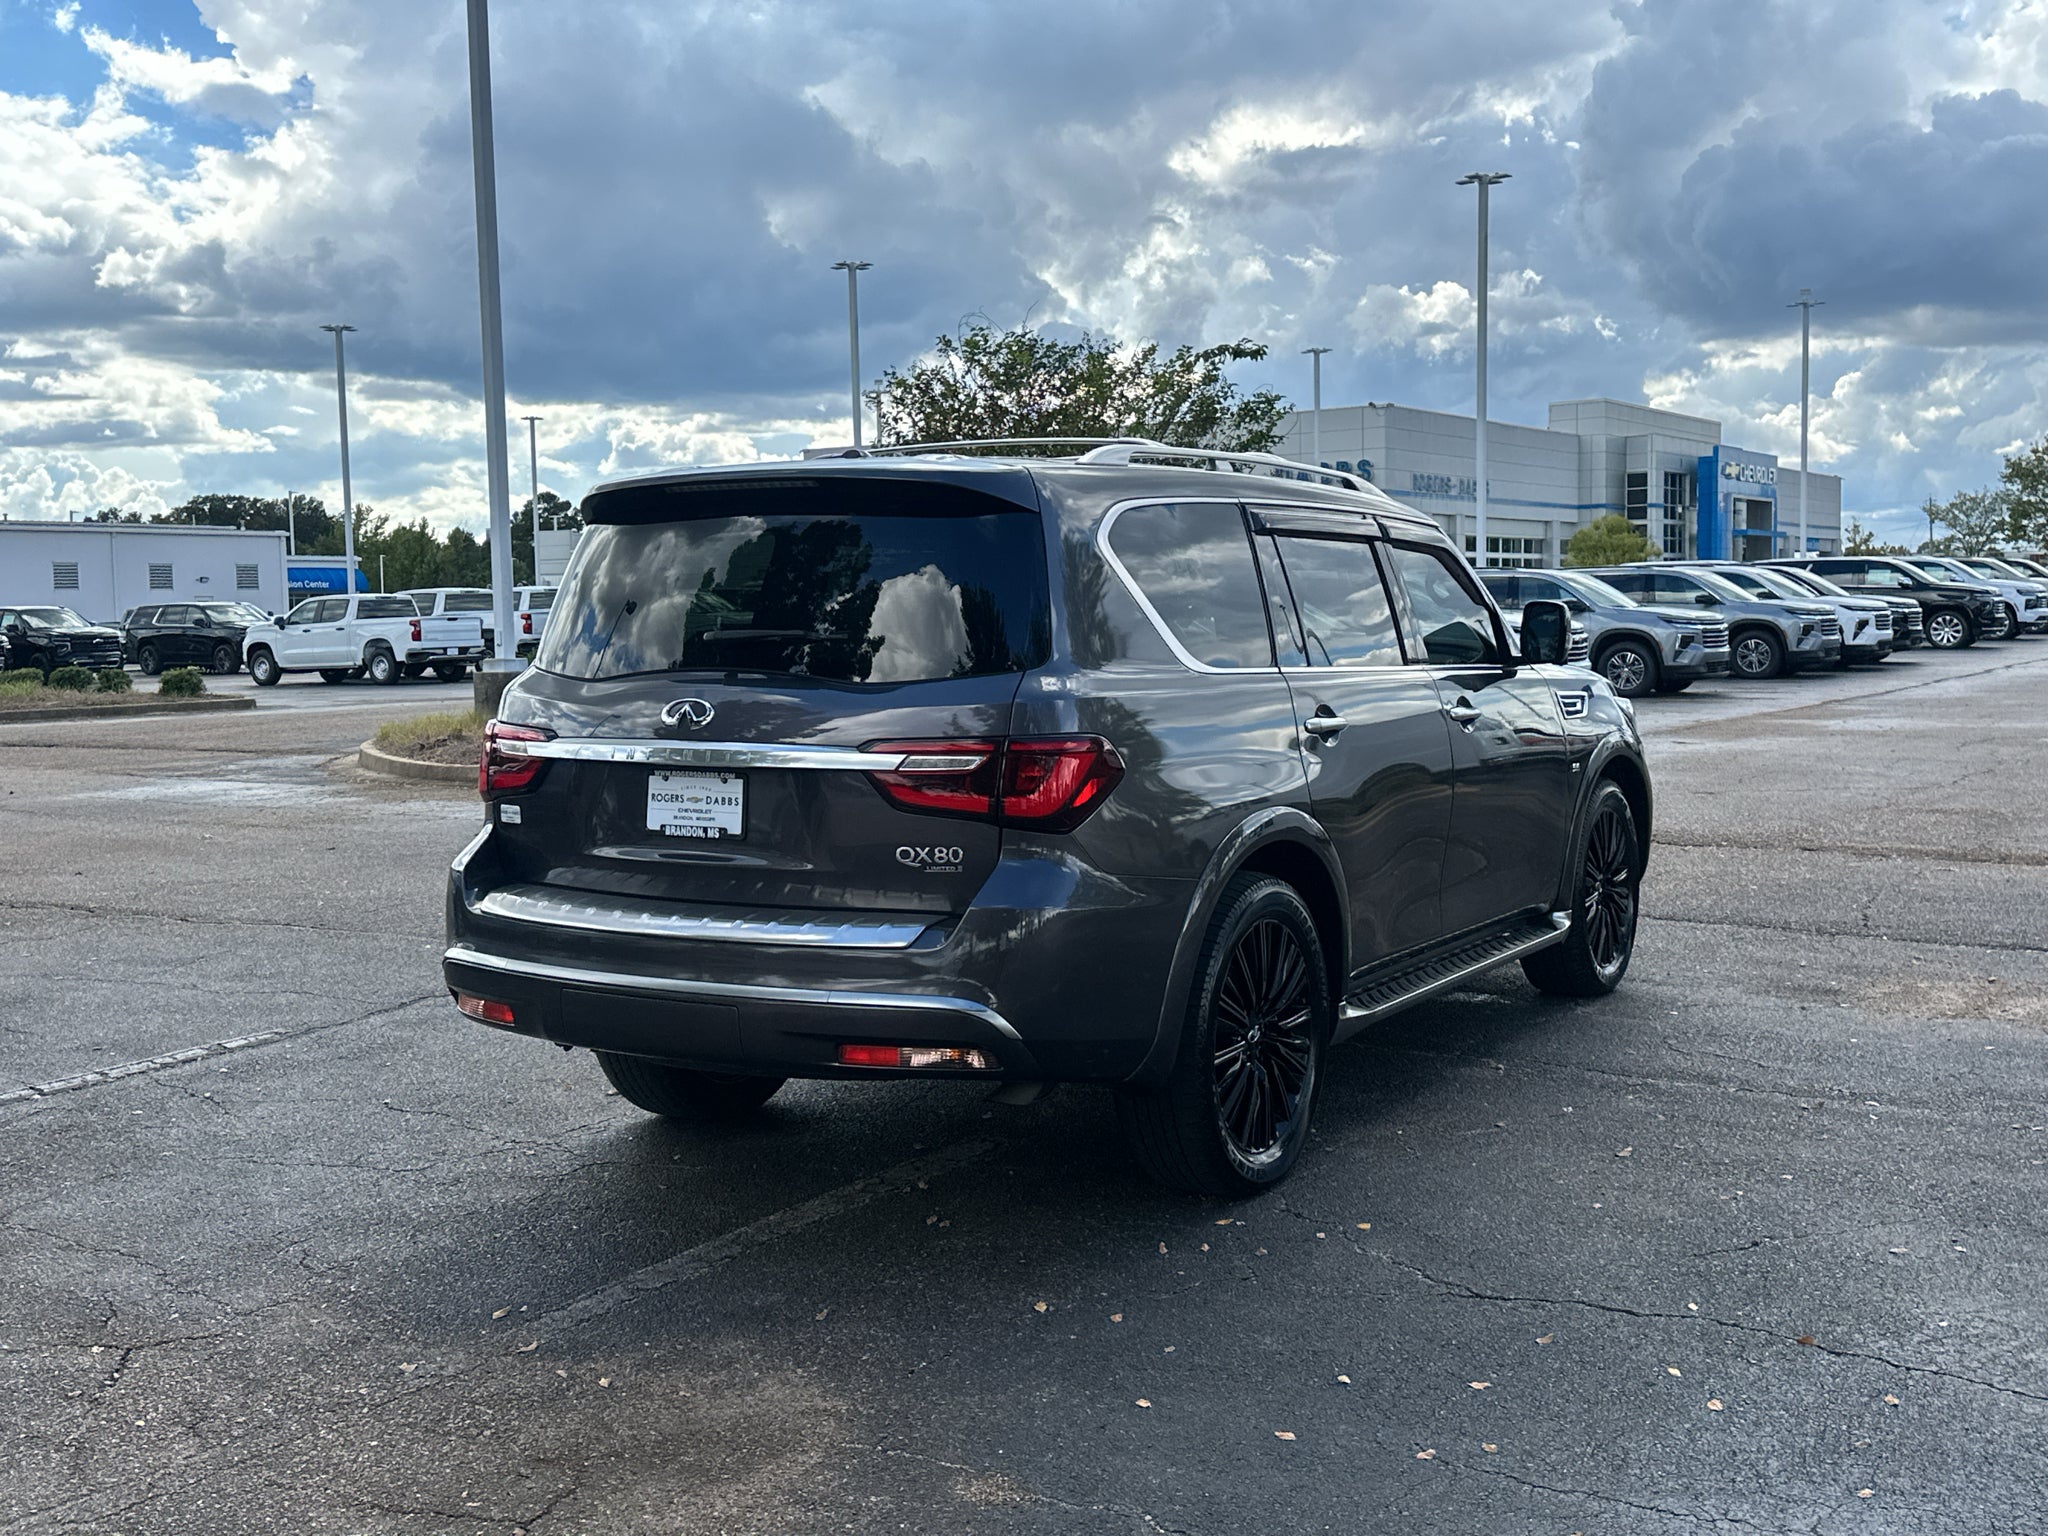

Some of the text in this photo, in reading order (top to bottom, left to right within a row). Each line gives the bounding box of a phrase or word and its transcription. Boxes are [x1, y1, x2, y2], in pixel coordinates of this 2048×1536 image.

[1740, 463, 1776, 484] CHEVROLET
[304, 580, 330, 589] Center
[611, 746, 751, 762] INFINITI
[654, 770, 736, 779] WWW.ROGERSDABBS.COM
[651, 793, 740, 807] ROGERS DABBS
[677, 807, 713, 815] CHEVROLET
[665, 825, 720, 839] BRANDON, MS
[895, 846, 964, 868] QX80
